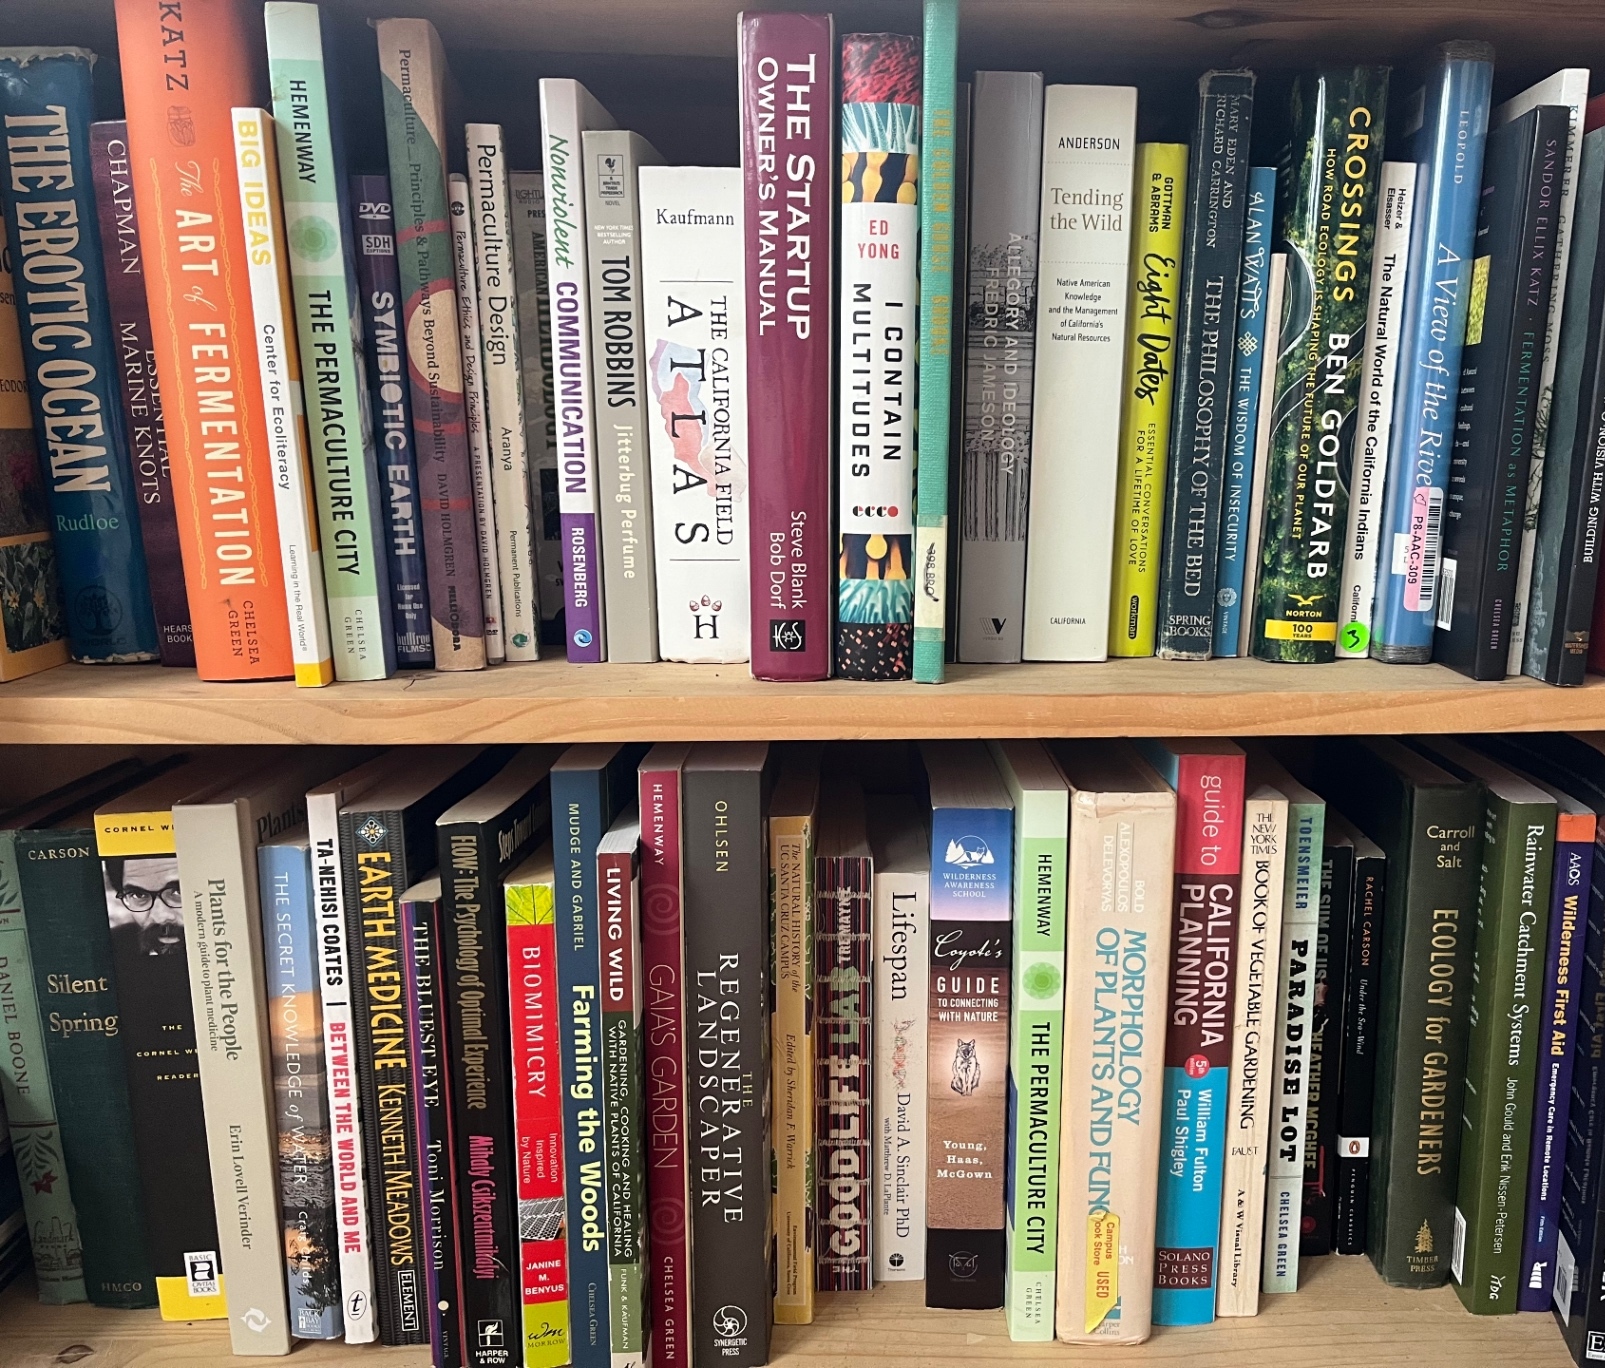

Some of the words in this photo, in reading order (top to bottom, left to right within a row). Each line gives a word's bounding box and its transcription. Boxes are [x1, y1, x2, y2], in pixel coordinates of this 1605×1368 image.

[158, 1, 190, 91] KATZ
[786, 53, 816, 140] THE
[4, 105, 75, 193] THE
[238, 120, 261, 168] BIG
[289, 80, 316, 184] HEMENWAY
[757, 56, 779, 201] OWNER'S
[1058, 136, 1120, 150] ANDERSON
[175, 160, 204, 197] The
[549, 134, 577, 269] Nonviolent
[1050, 188, 1124, 211] Tending
[1161, 176, 1174, 230] GOTTMAN
[1333, 106, 1372, 302] CROSSINGS
[108, 139, 141, 275] CHAPMAN
[244, 181, 272, 266] IDEAS
[477, 144, 504, 288] Permaculture
[656, 208, 735, 226] Kaufmann
[869, 220, 889, 236] ED
[1050, 213, 1078, 230] the
[1082, 214, 1122, 232] Wild
[1149, 185, 1160, 233] ABRAMS
[176, 209, 219, 277] ART
[786, 154, 816, 340] STARTUP
[857, 243, 900, 259] YONG
[16, 199, 92, 352] EROTIC
[182, 285, 218, 312] of
[601, 255, 632, 302] TOM
[758, 210, 779, 336] MANUAL
[1056, 279, 1076, 287] Native
[1078, 278, 1111, 287] American
[1064, 292, 1102, 302] Knowledge
[1135, 252, 1176, 325] Eight
[308, 290, 334, 332] THE
[710, 295, 728, 340] THE
[1202, 275, 1224, 326] THE
[264, 324, 278, 375] Center
[486, 296, 507, 366] Design
[372, 291, 408, 450] SYMBIOTIC
[604, 311, 636, 408] ROBBINS
[851, 284, 872, 477] MULTITUDES
[1134, 333, 1172, 406] Dates
[1323, 333, 1350, 394] BEN
[270, 380, 280, 402] for
[556, 282, 586, 494] COMMUNICATION
[711, 348, 732, 476] CALIFORNIA
[883, 327, 904, 460] CONTAIN
[1192, 330, 1220, 466] PHILOSOPHY
[38, 359, 111, 492] OCEAN
[314, 342, 354, 521] PERMACULTURE
[667, 295, 710, 544] ATLAS
[188, 323, 256, 585] FERMENTATION
[273, 406, 290, 490] Ecoliteracy
[501, 427, 513, 471] Aranya
[614, 424, 636, 504] Jitterbug
[388, 464, 416, 556] EARTH
[1191, 470, 1208, 501] OF
[1307, 409, 1342, 579] GOLDFARB
[715, 483, 733, 545] FIELD
[791, 511, 807, 557] Steve
[1187, 503, 1206, 550] THE
[334, 529, 360, 576] CITY
[571, 527, 588, 608] ROSENBERG
[621, 509, 637, 579] Perfume
[770, 532, 785, 566] Bob
[1407, 516, 1423, 584] P8-AAC-309
[770, 571, 786, 610] Dorf
[791, 562, 808, 608] Blank
[1184, 554, 1203, 597] BED
[227, 609, 243, 657] GREEN
[242, 599, 260, 665] CHELSEA
[1129, 597, 1139, 638] workman
[1169, 614, 1211, 625] SPRING
[1169, 626, 1210, 637] BOOKS
[1286, 609, 1322, 618] NORTON
[1292, 624, 1313, 633] 100
[653, 783, 665, 865] HEMENWAY
[1200, 775, 1225, 838] guide
[1426, 826, 1475, 840] Carroll
[28, 846, 90, 860] CARSON
[714, 800, 729, 872] OHLSEN
[1200, 845, 1221, 866] to
[1436, 855, 1462, 869] Salt
[1440, 841, 1460, 852] and
[316, 838, 339, 922] TA-NEHISI
[942, 873, 997, 881] WILDERNESS
[1295, 817, 1313, 910] TOENSMEIER
[1522, 825, 1544, 907] Rainwater
[207, 877, 227, 938] Plants
[357, 852, 396, 938] EARTH
[606, 867, 622, 941] LIVING
[952, 890, 986, 898] SCHOOL
[1037, 854, 1053, 937] HEMENWAY
[216, 940, 235, 966] for
[322, 924, 343, 986] COATES
[882, 891, 917, 1001] Lifespan
[934, 930, 1003, 972] Coyote's
[1174, 884, 1206, 1025] PLANNING
[1200, 884, 1234, 1048] CALIFORNIA
[1427, 908, 1459, 1007] ECOLOGY
[1514, 911, 1537, 999] Catchment
[47, 974, 108, 995] Silent
[218, 970, 232, 1000] the
[607, 947, 624, 1002] WILD
[936, 976, 1000, 994] GUIDE
[49, 1012, 118, 1038] Spring
[365, 946, 407, 1070] MEDICINE
[522, 946, 546, 1098] BIOMIMICRY
[938, 998, 949, 1008] TO
[950, 998, 999, 1008] CONNECTING
[939, 1011, 962, 1022] WITH
[964, 1011, 998, 1022] NATURE
[1282, 940, 1308, 1096] PARADISE
[1425, 1016, 1452, 1044] for
[220, 1002, 239, 1062] People
[571, 985, 599, 1099] Farming
[1029, 1022, 1050, 1058] THE
[1507, 1004, 1529, 1066] Systems
[328, 1022, 350, 1100] BETWEEN
[696, 970, 720, 1207] LANDSCAPER
[719, 954, 743, 1223] REGENERATIVE
[1175, 1089, 1191, 1121] Paul
[1195, 1089, 1212, 1142] William
[1417, 1051, 1448, 1175] GARDENERS
[335, 1102, 354, 1133] THE
[378, 1084, 406, 1168] KENNETH
[577, 1107, 601, 1153] the
[1027, 1064, 1050, 1210] PERMACULTURE
[1280, 1106, 1298, 1162] LOT
[336, 1138, 356, 1191] WORLD
[426, 1139, 442, 1185] Toni
[943, 1140, 987, 1151] Young,
[946, 1155, 984, 1166] Haas,
[1170, 1124, 1189, 1177] Shigley
[1192, 1146, 1209, 1192] Fulton
[936, 1170, 992, 1179] McGown
[341, 1196, 359, 1228] AND
[384, 1171, 414, 1266] MEADOWS
[429, 1188, 447, 1270] Morrison
[578, 1161, 605, 1252] Woods
[344, 1230, 361, 1253] ME
[1026, 1216, 1045, 1255] CITY
[1158, 1251, 1210, 1261] SOLANO
[525, 1284, 564, 1295] BENYUS
[526, 1260, 562, 1270] JANINE
[1096, 1271, 1109, 1299] USED
[1158, 1263, 1208, 1273] PRESS
[1158, 1275, 1208, 1285] BOOKS
